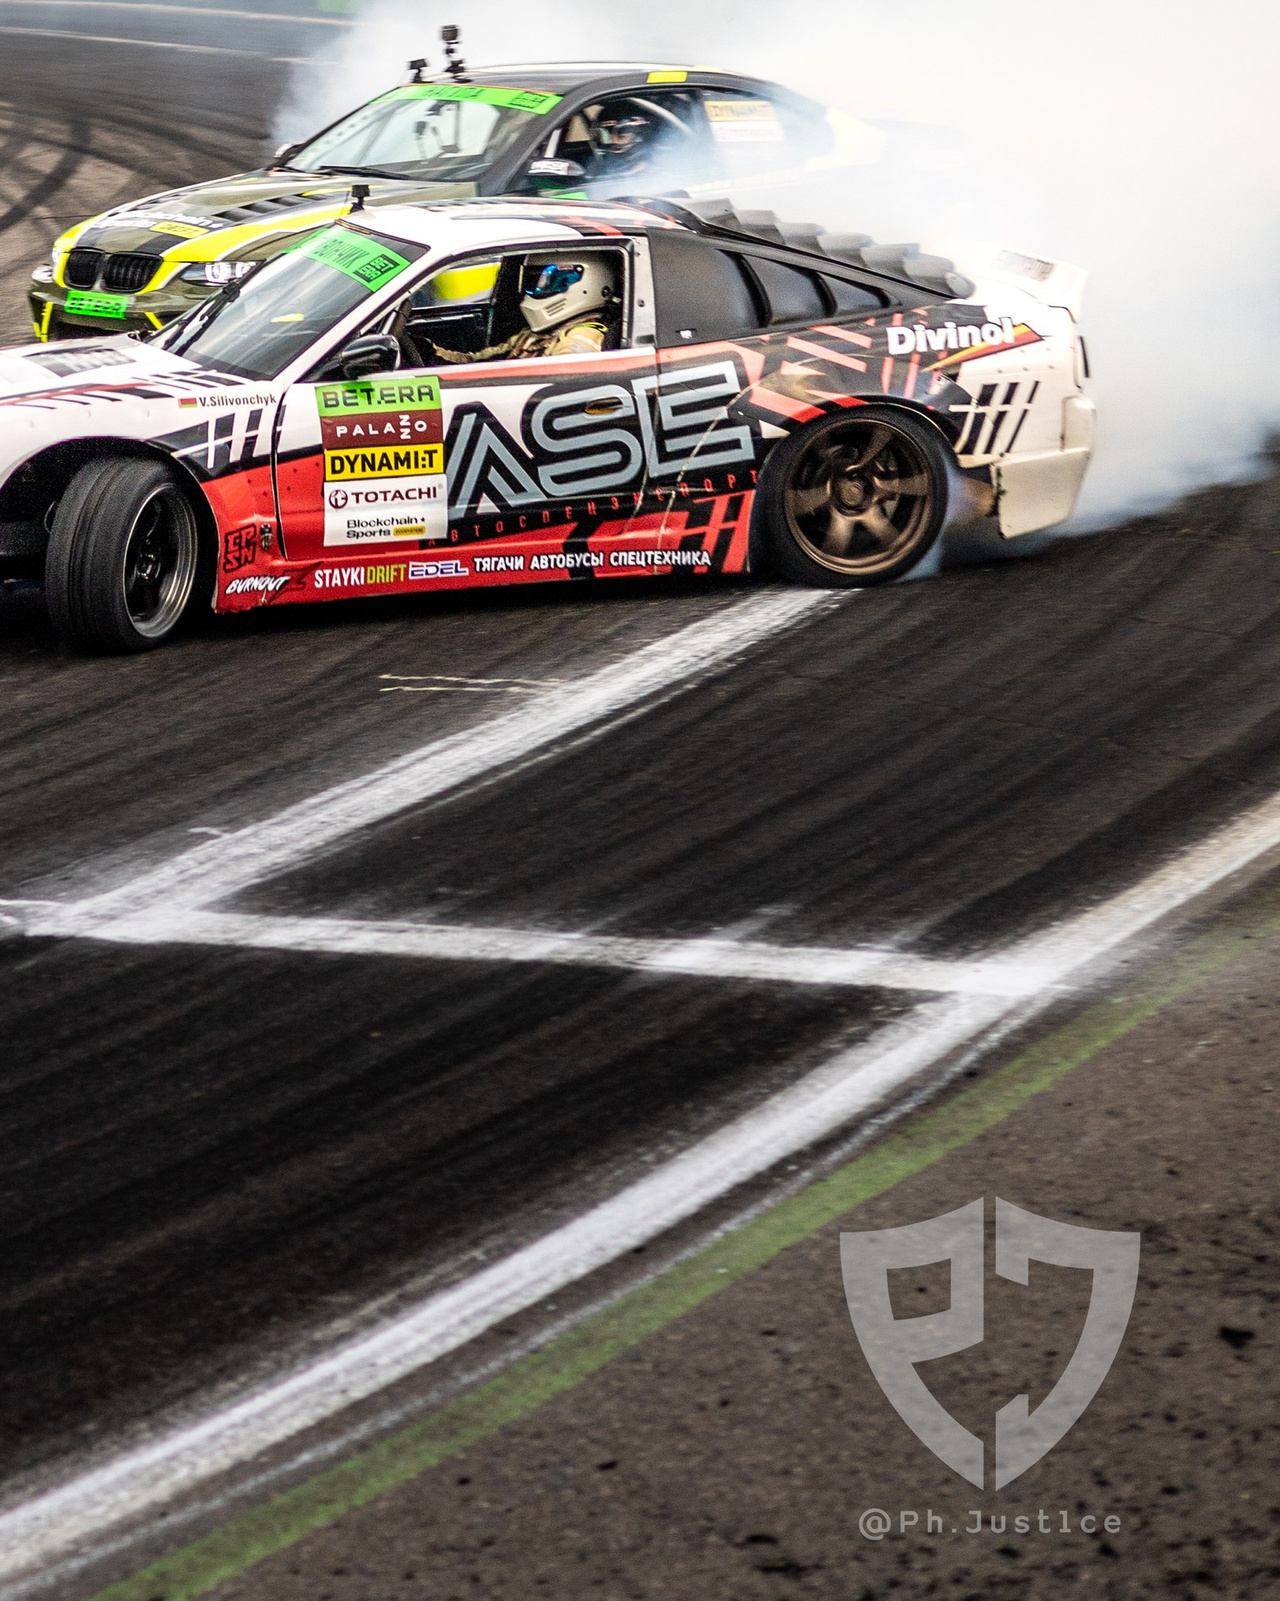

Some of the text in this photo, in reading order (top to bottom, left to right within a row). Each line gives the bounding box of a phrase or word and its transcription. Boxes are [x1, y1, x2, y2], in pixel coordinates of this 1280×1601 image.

[886, 316, 1016, 355] Divinol
[199, 393, 278, 408] V.Silivonchyk
[322, 384, 435, 409] BET.ERA
[330, 449, 439, 475] DYNAMI:T
[351, 486, 438, 504] TOTACHI
[346, 515, 419, 529] Blockchain
[346, 528, 391, 540] Sports
[474, 550, 711, 572] ТЯГАЧИ АВТОБУСЫ СПЕЦТЕХНИКА
